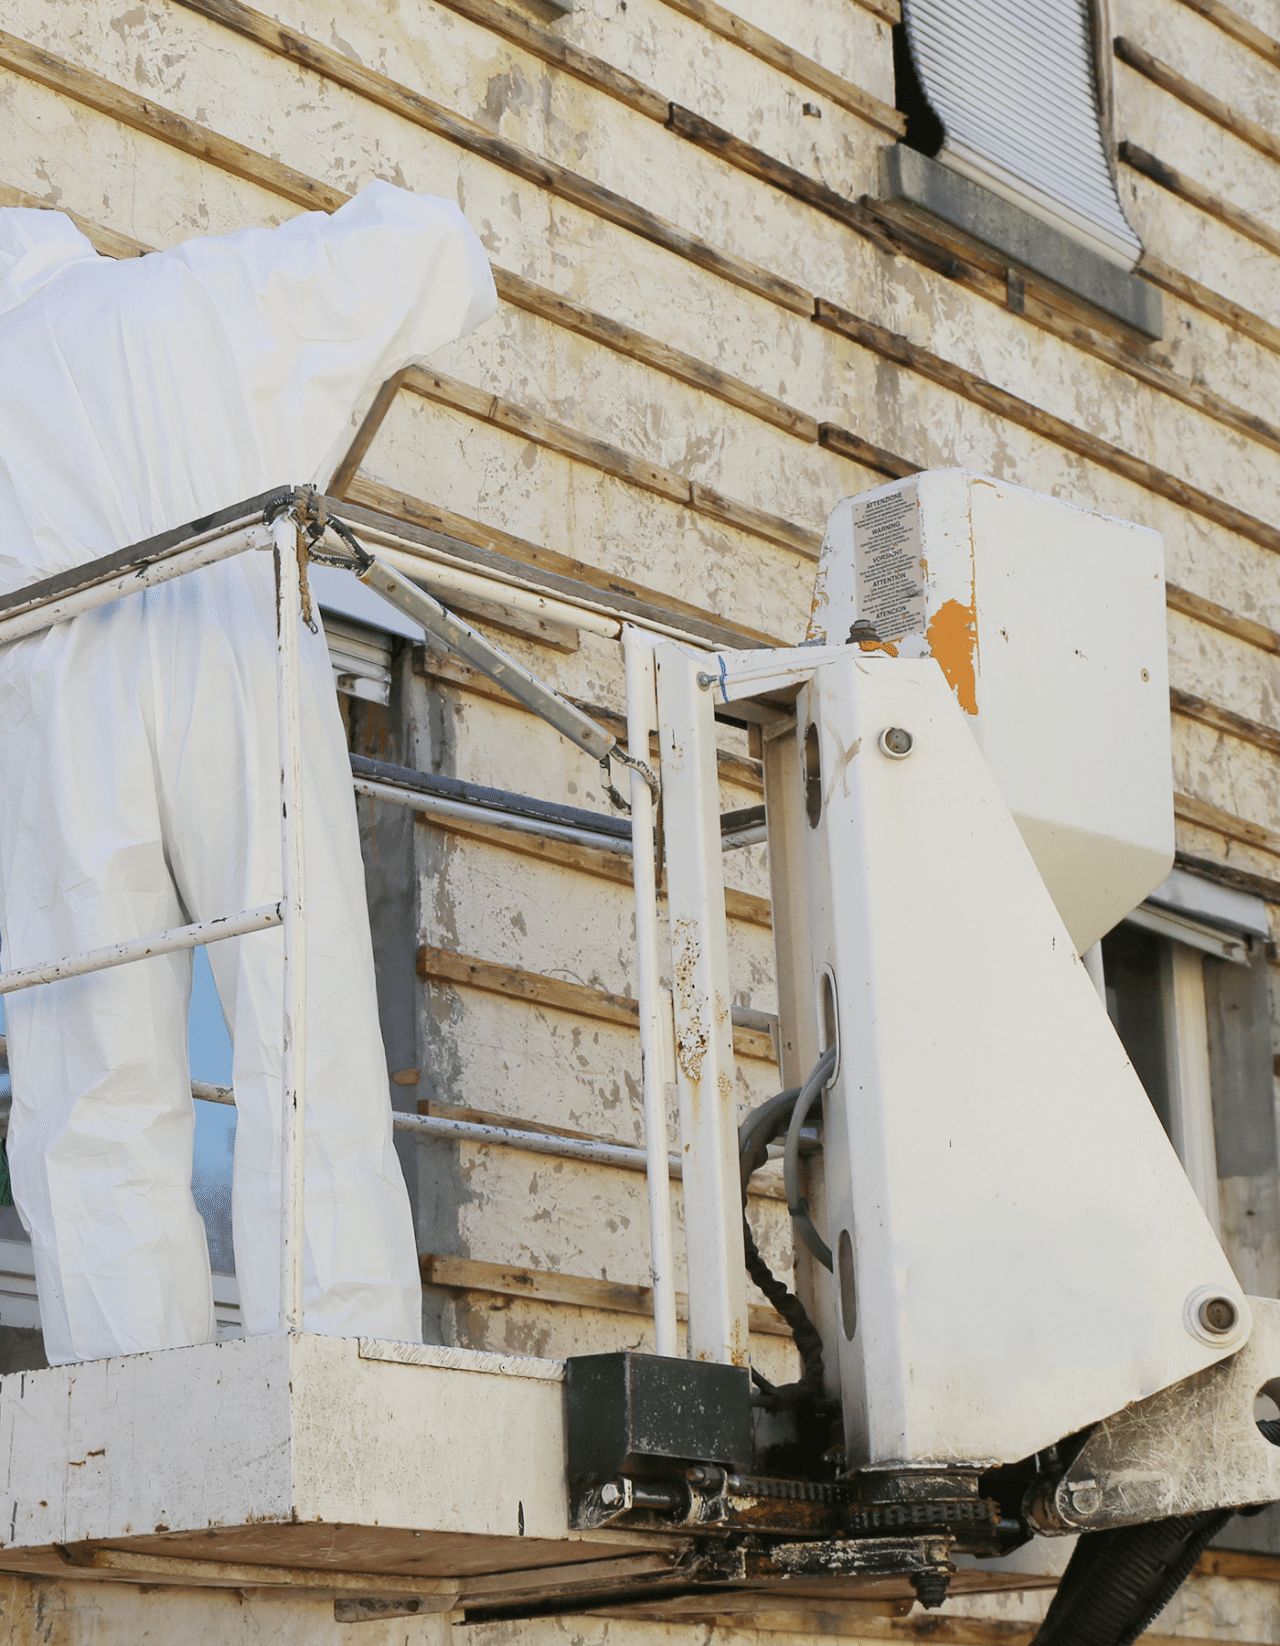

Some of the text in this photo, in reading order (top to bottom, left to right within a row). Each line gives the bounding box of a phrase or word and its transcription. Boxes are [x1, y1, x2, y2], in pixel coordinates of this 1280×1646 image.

[866, 492, 902, 509] ATTENZIONE
[872, 521, 900, 535] WARNING
[872, 548, 903, 563] VORSICHT
[873, 572, 906, 587] ATTENTION
